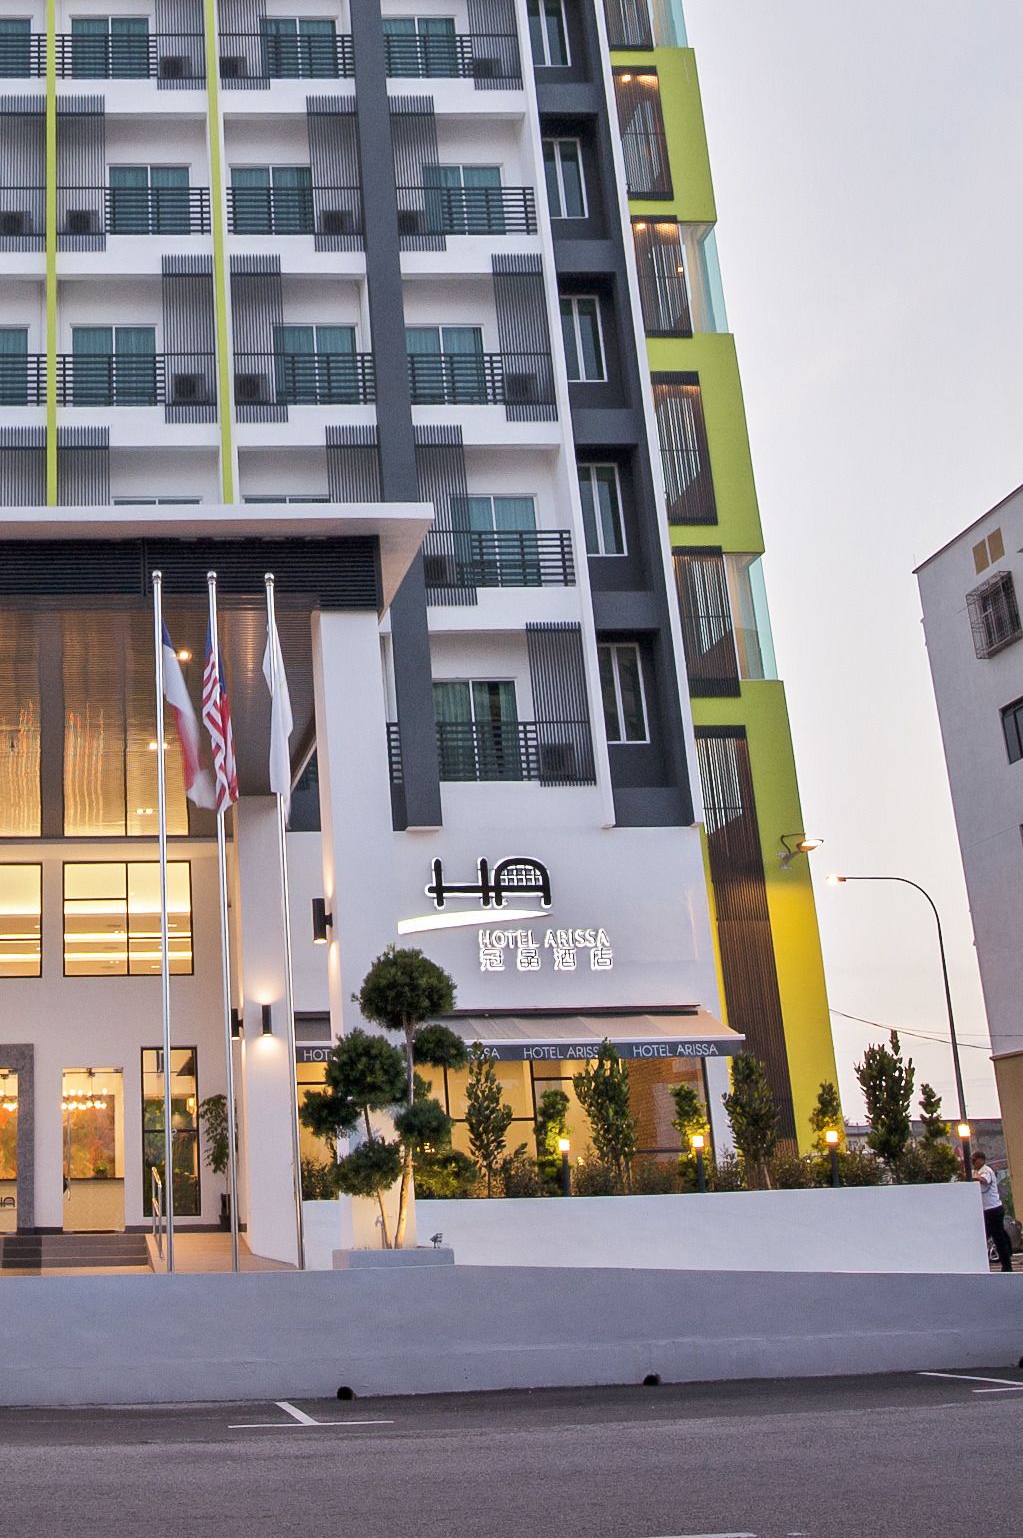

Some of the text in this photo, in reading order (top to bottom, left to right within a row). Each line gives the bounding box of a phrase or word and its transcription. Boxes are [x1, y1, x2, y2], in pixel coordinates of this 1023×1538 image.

[478, 929, 611, 948] HOTEL ARISSA
[523, 1046, 599, 1059] HOTEL ARISS
[633, 1043, 718, 1057] HOTEL ARISSA
